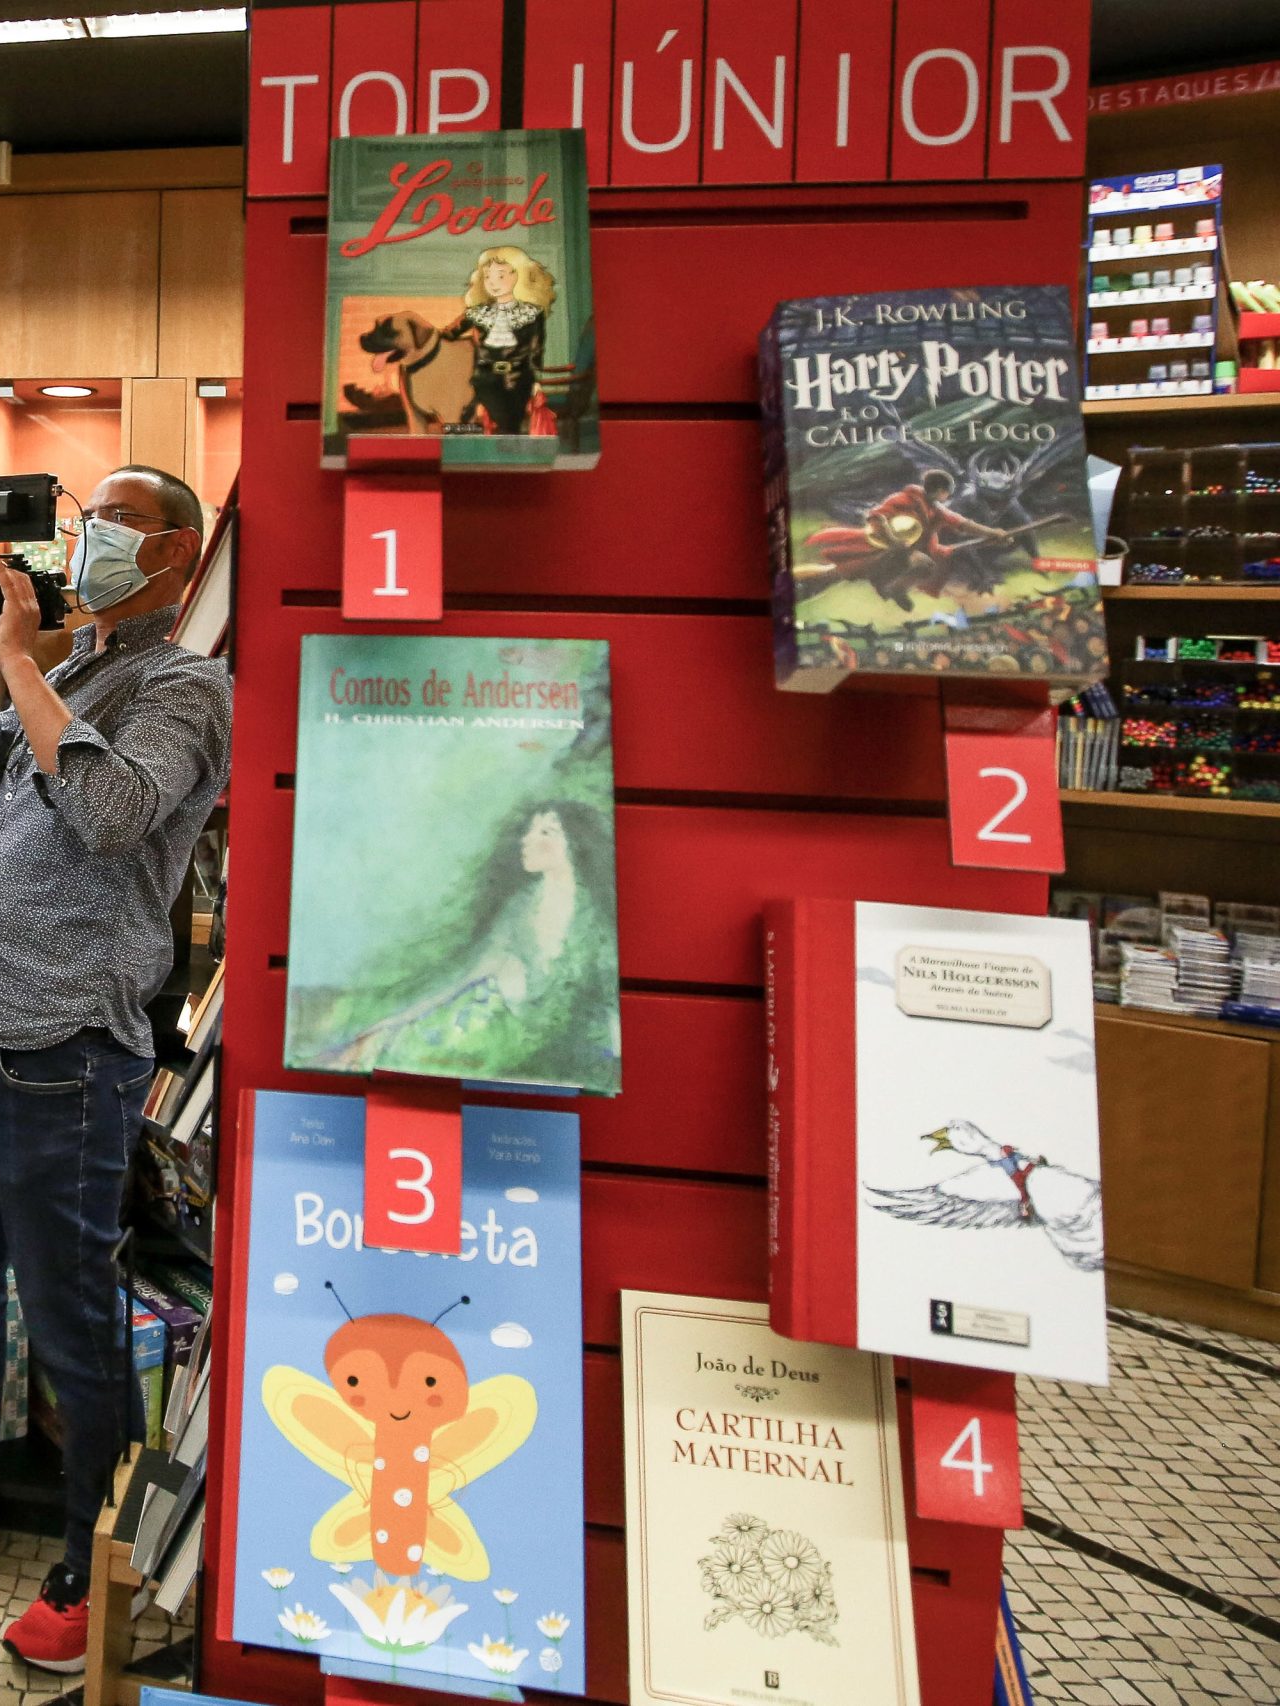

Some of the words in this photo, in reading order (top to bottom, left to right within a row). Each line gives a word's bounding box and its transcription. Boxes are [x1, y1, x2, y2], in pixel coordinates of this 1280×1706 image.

[261, 68, 490, 163] TOP
[571, 29, 1072, 154] JÚNIOR
[340, 158, 556, 257] Lorde
[815, 305, 864, 333] J.K.
[875, 301, 1027, 325] ROWLING
[785, 349, 919, 412] Harry
[922, 340, 1069, 410] Potter
[861, 405, 880, 421] O
[925, 427, 957, 442] DE
[969, 420, 1056, 443] FOGO
[371, 529, 410, 597] 1
[329, 667, 412, 707] Contos
[422, 668, 452, 708] de
[463, 671, 579, 710] Andersen
[324, 712, 345, 725] H.
[352, 714, 464, 728] CHRISTIAN
[472, 717, 584, 730] ANDERSEN
[977, 767, 1032, 844] 2
[903, 966, 938, 979] NILS
[942, 971, 1040, 990] HOLGERSSON
[919, 956, 980, 970] Maravilhosa
[387, 1148, 436, 1225] 3
[695, 1352, 737, 1375] João
[743, 1356, 765, 1377] de
[771, 1360, 820, 1384] Deus
[675, 1407, 846, 1451] CARTILHA
[671, 1439, 855, 1487] MATERNAL
[940, 1417, 993, 1497] 4
